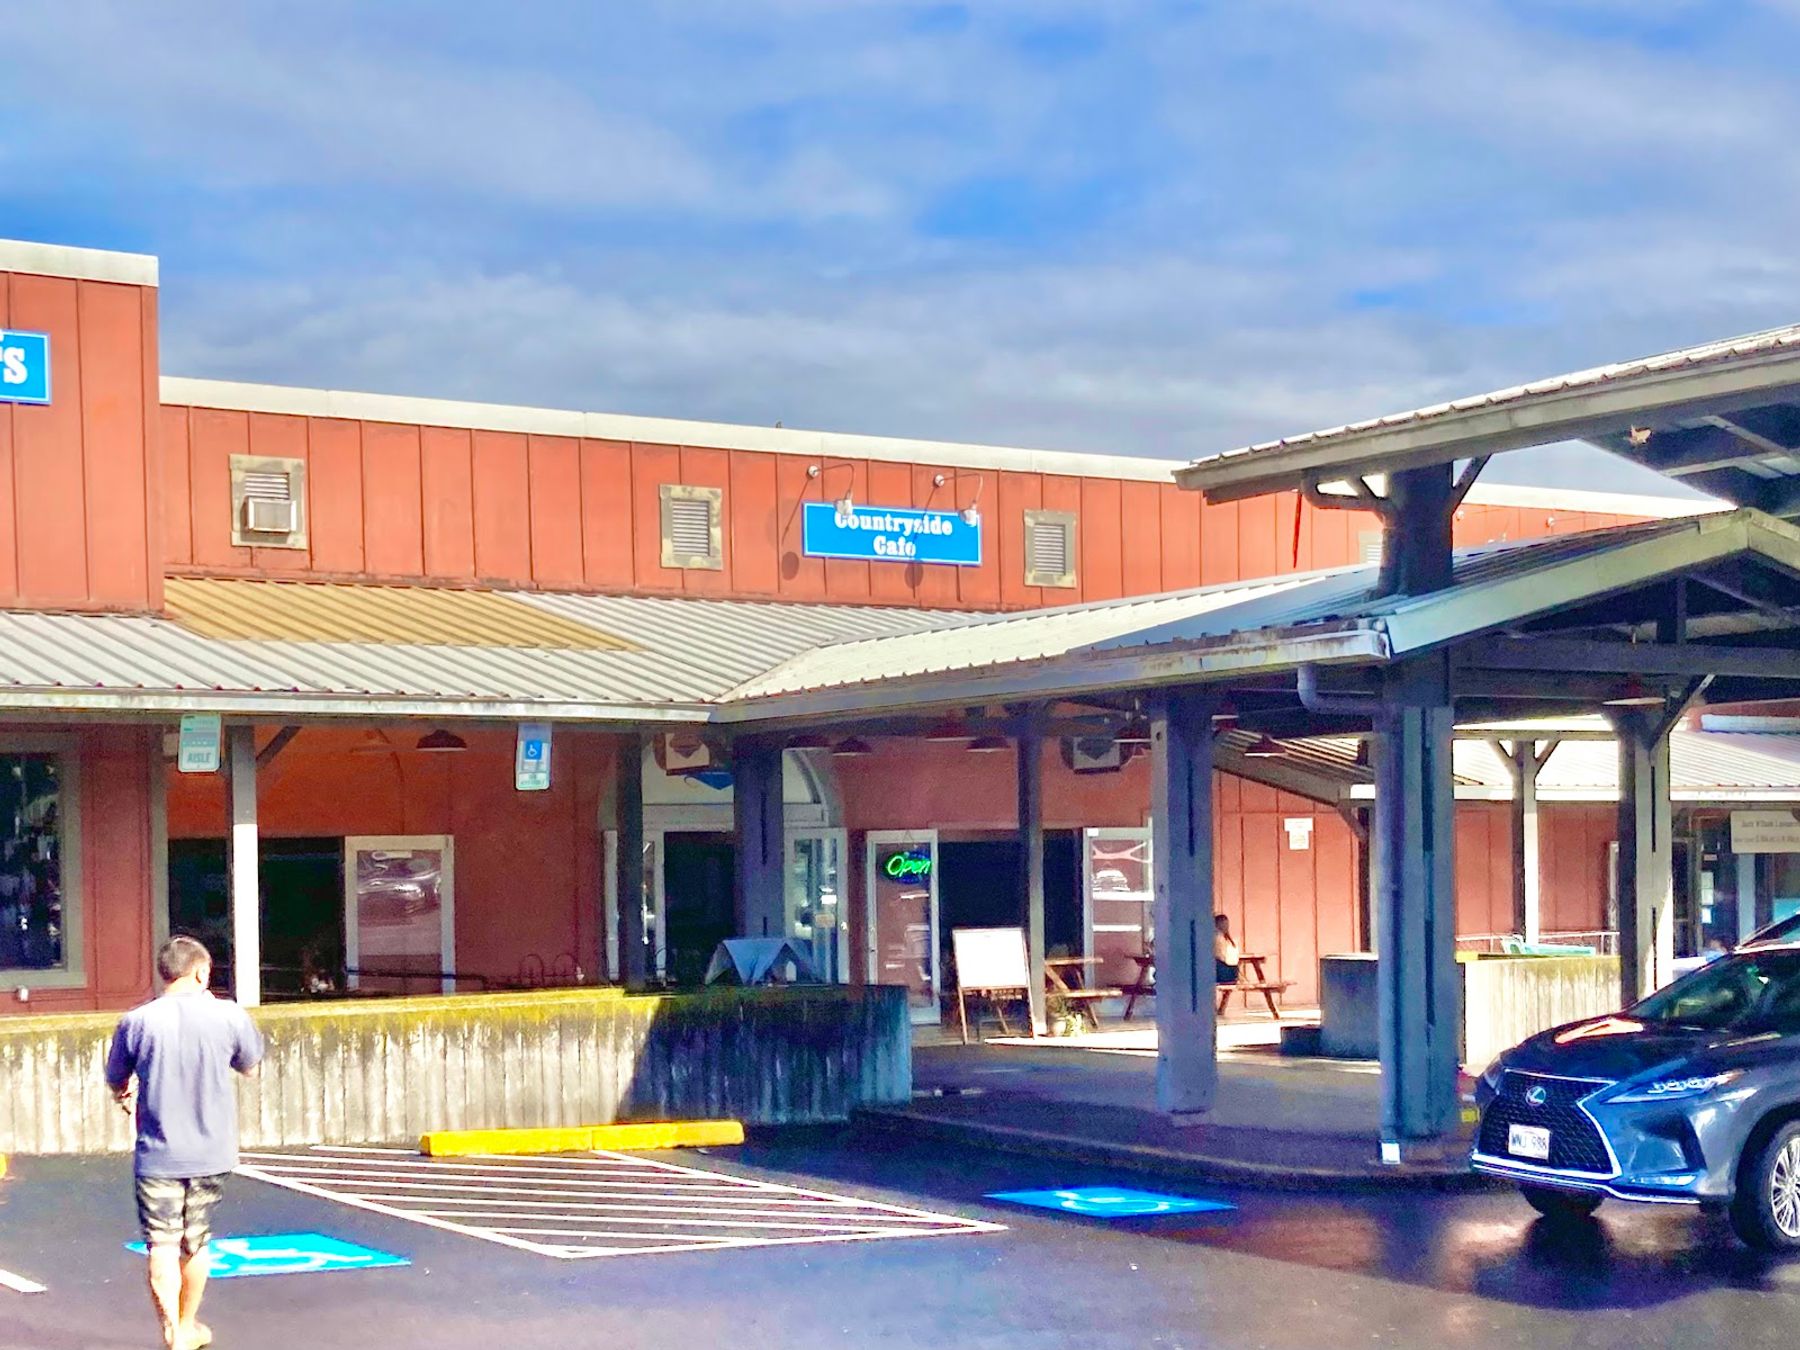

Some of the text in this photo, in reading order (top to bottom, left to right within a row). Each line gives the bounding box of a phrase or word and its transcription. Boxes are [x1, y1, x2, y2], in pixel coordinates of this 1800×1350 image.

[834, 510, 953, 536] Countryside
[873, 536, 917, 557] Cafe
[888, 855, 931, 877] Open
